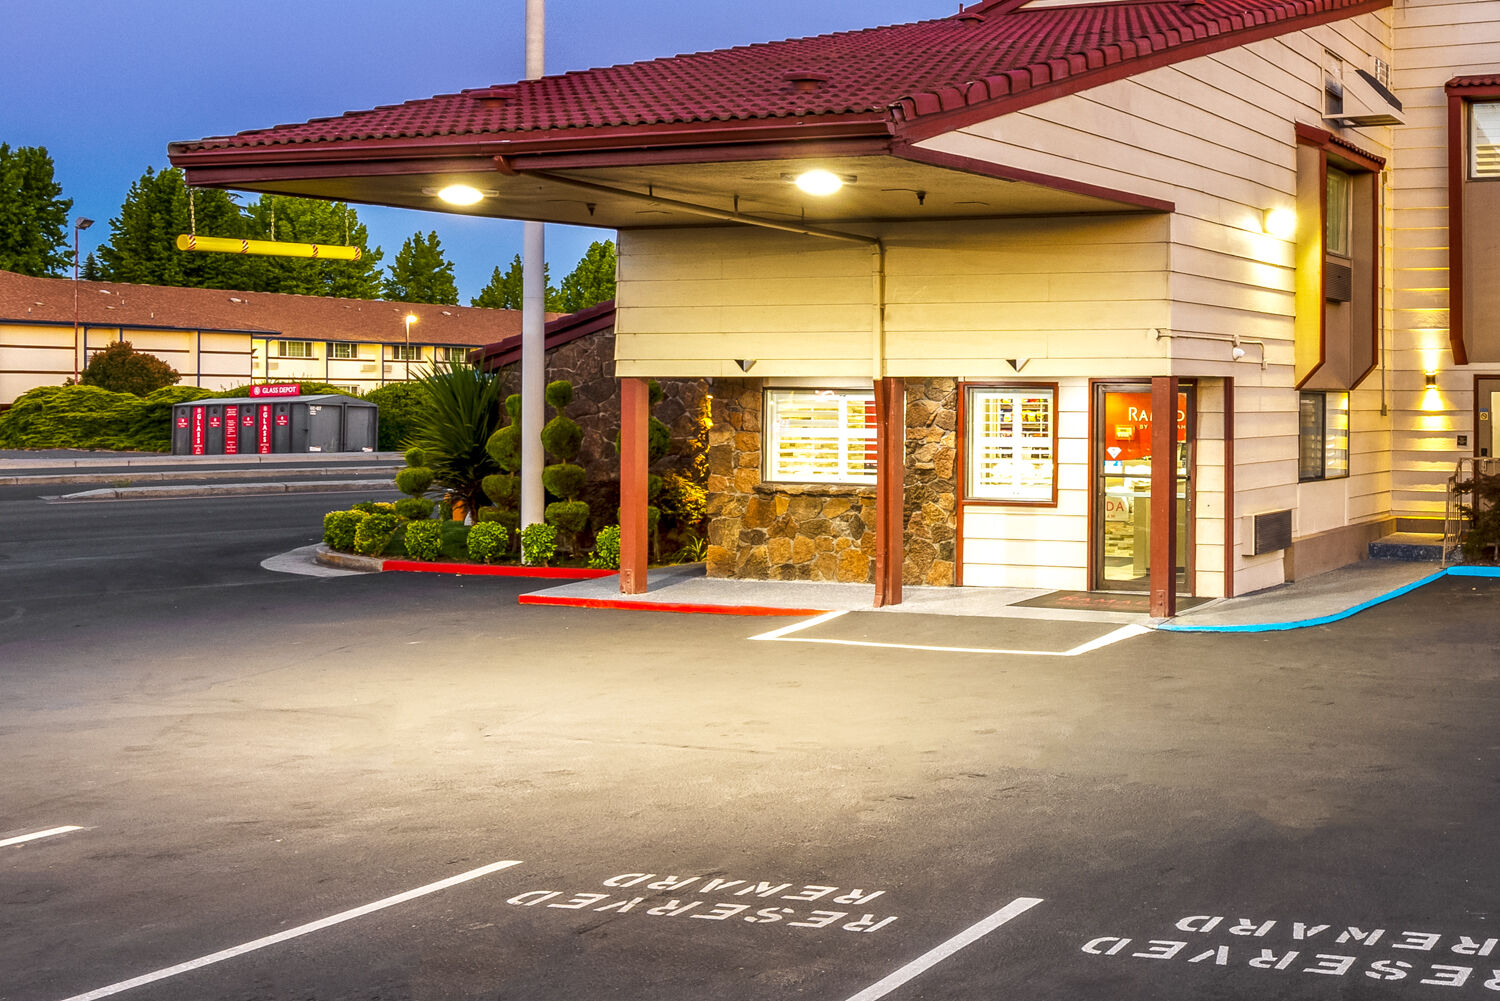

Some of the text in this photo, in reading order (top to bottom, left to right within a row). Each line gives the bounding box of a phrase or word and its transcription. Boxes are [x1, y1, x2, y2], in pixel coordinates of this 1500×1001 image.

[603, 872, 886, 905] REWARD
[506, 890, 898, 933] RESERVED
[1175, 915, 1499, 957] REWARD
